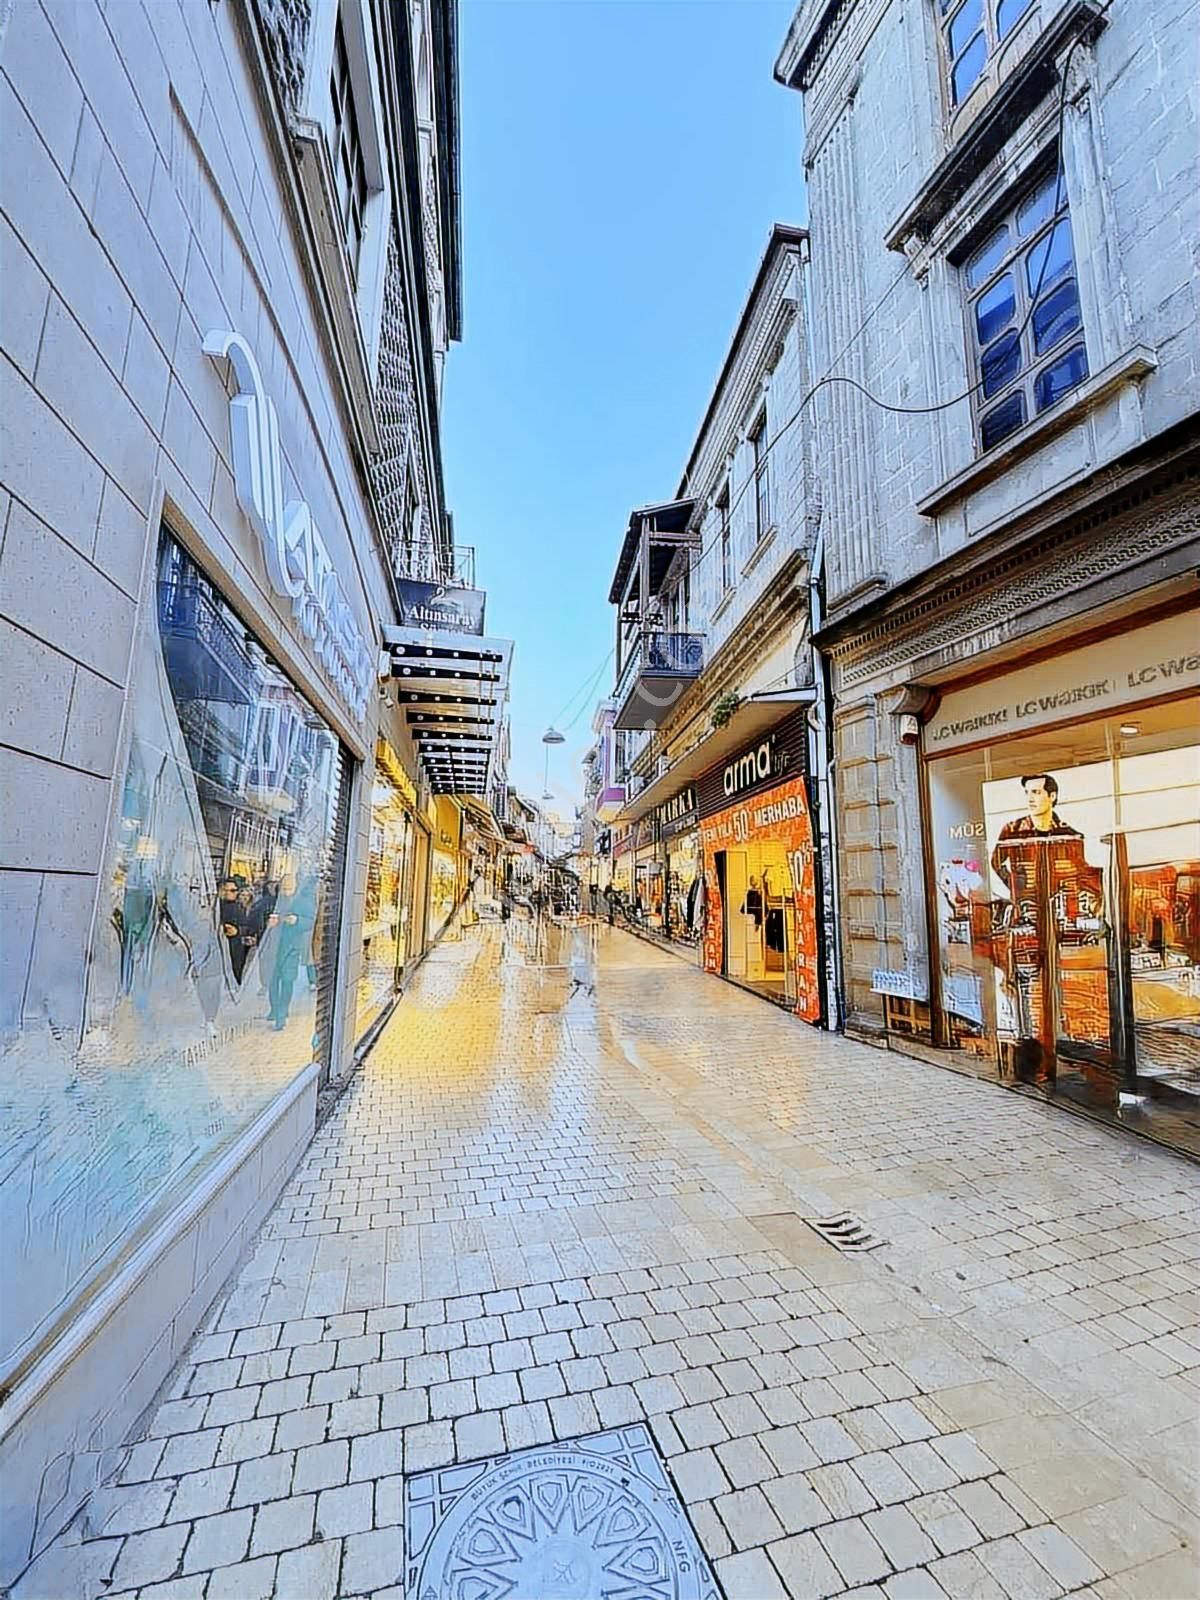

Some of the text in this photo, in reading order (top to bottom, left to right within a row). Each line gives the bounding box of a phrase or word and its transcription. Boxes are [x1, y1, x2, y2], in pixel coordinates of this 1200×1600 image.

[723, 741, 770, 797] arma
[754, 794, 806, 828] MERHABA
[672, 1539, 691, 1573] NFG
